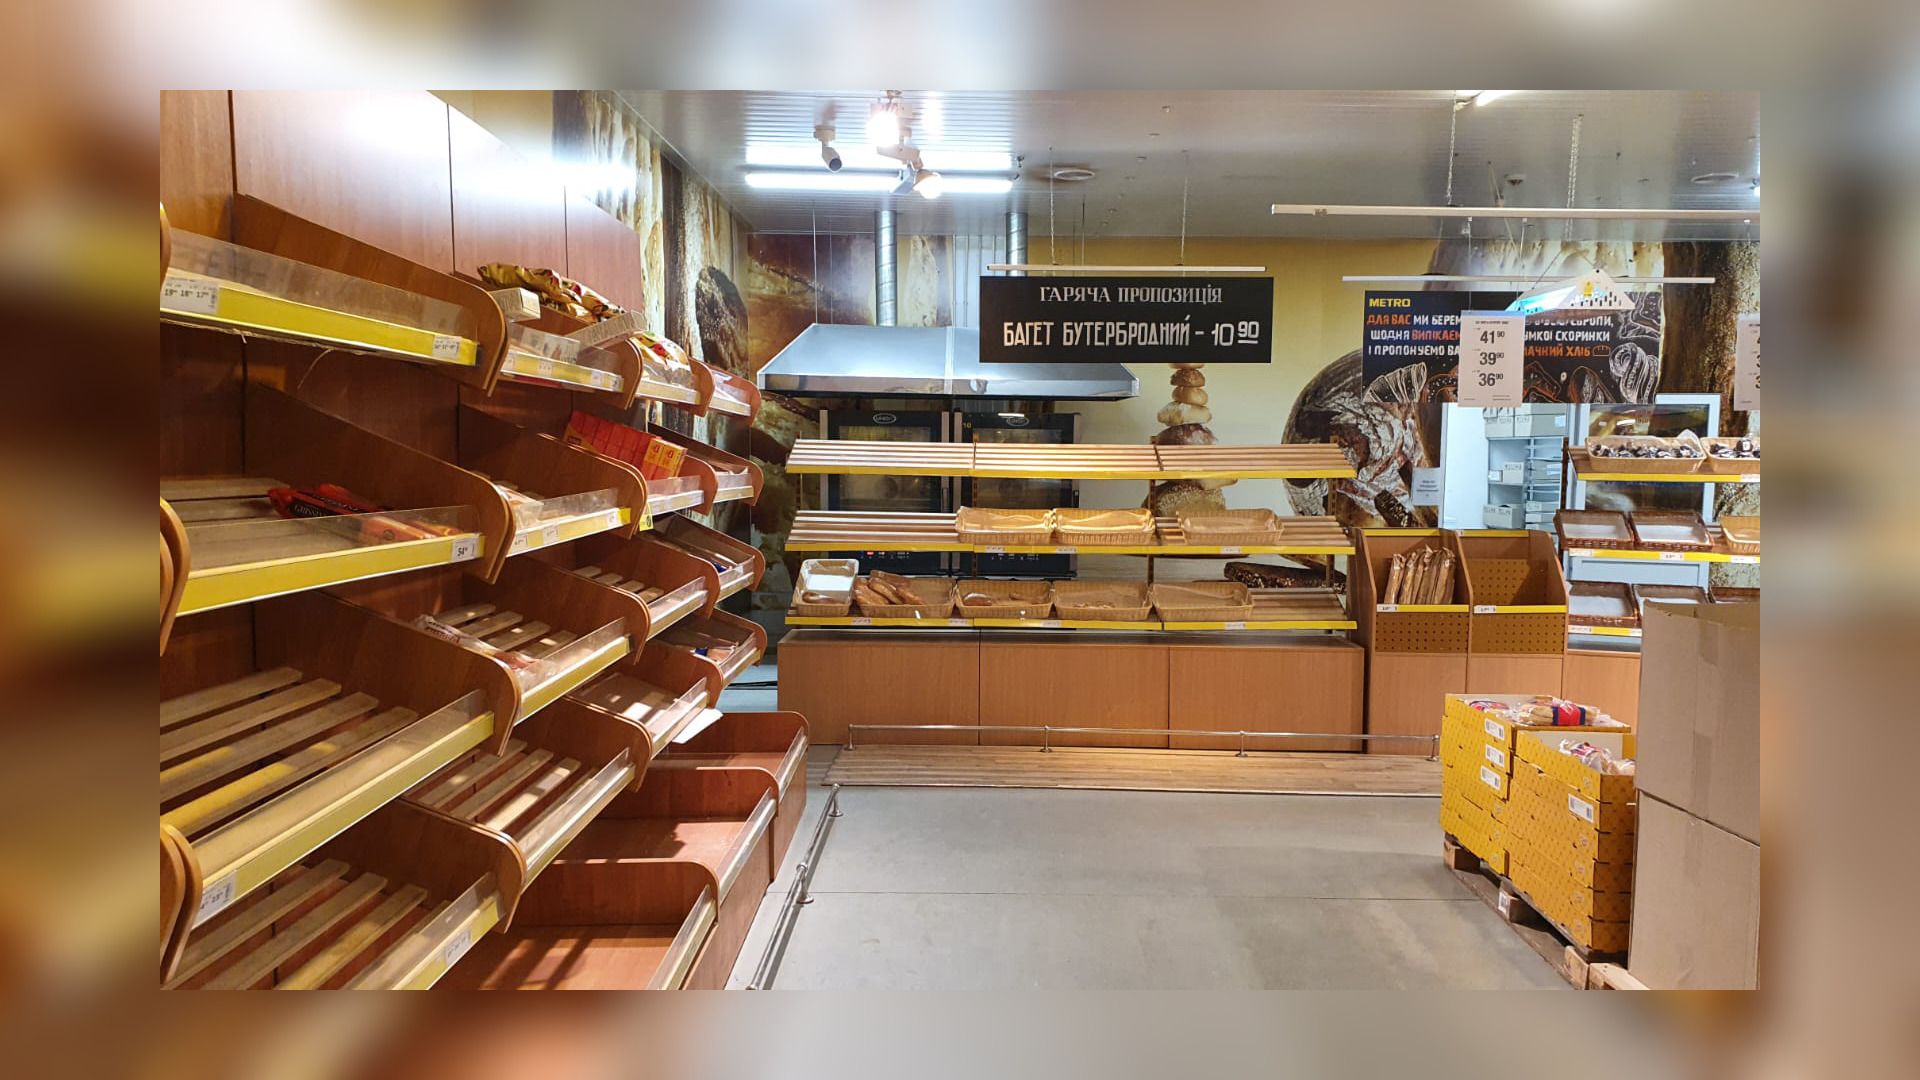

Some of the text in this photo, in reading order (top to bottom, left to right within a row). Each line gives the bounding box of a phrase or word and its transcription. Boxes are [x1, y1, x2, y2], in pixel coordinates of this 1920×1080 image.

[1040, 286, 1111, 302] ГАРЯЧА
[1369, 298, 1411, 308] METRO
[1367, 314, 1389, 325] ДЛЯ
[1391, 314, 1411, 325] ВАС
[1413, 315, 1428, 325] МИ
[1003, 321, 1054, 346] БАГЕТ
[1063, 314, 1191, 346] БУТЕРБРОДНИЙ
[1555, 331, 1610, 341] СКОРИНКИ
[1374, 345, 1444, 355] ПРОПОНУЄМО
[1566, 345, 1591, 356] ХЛІБ
